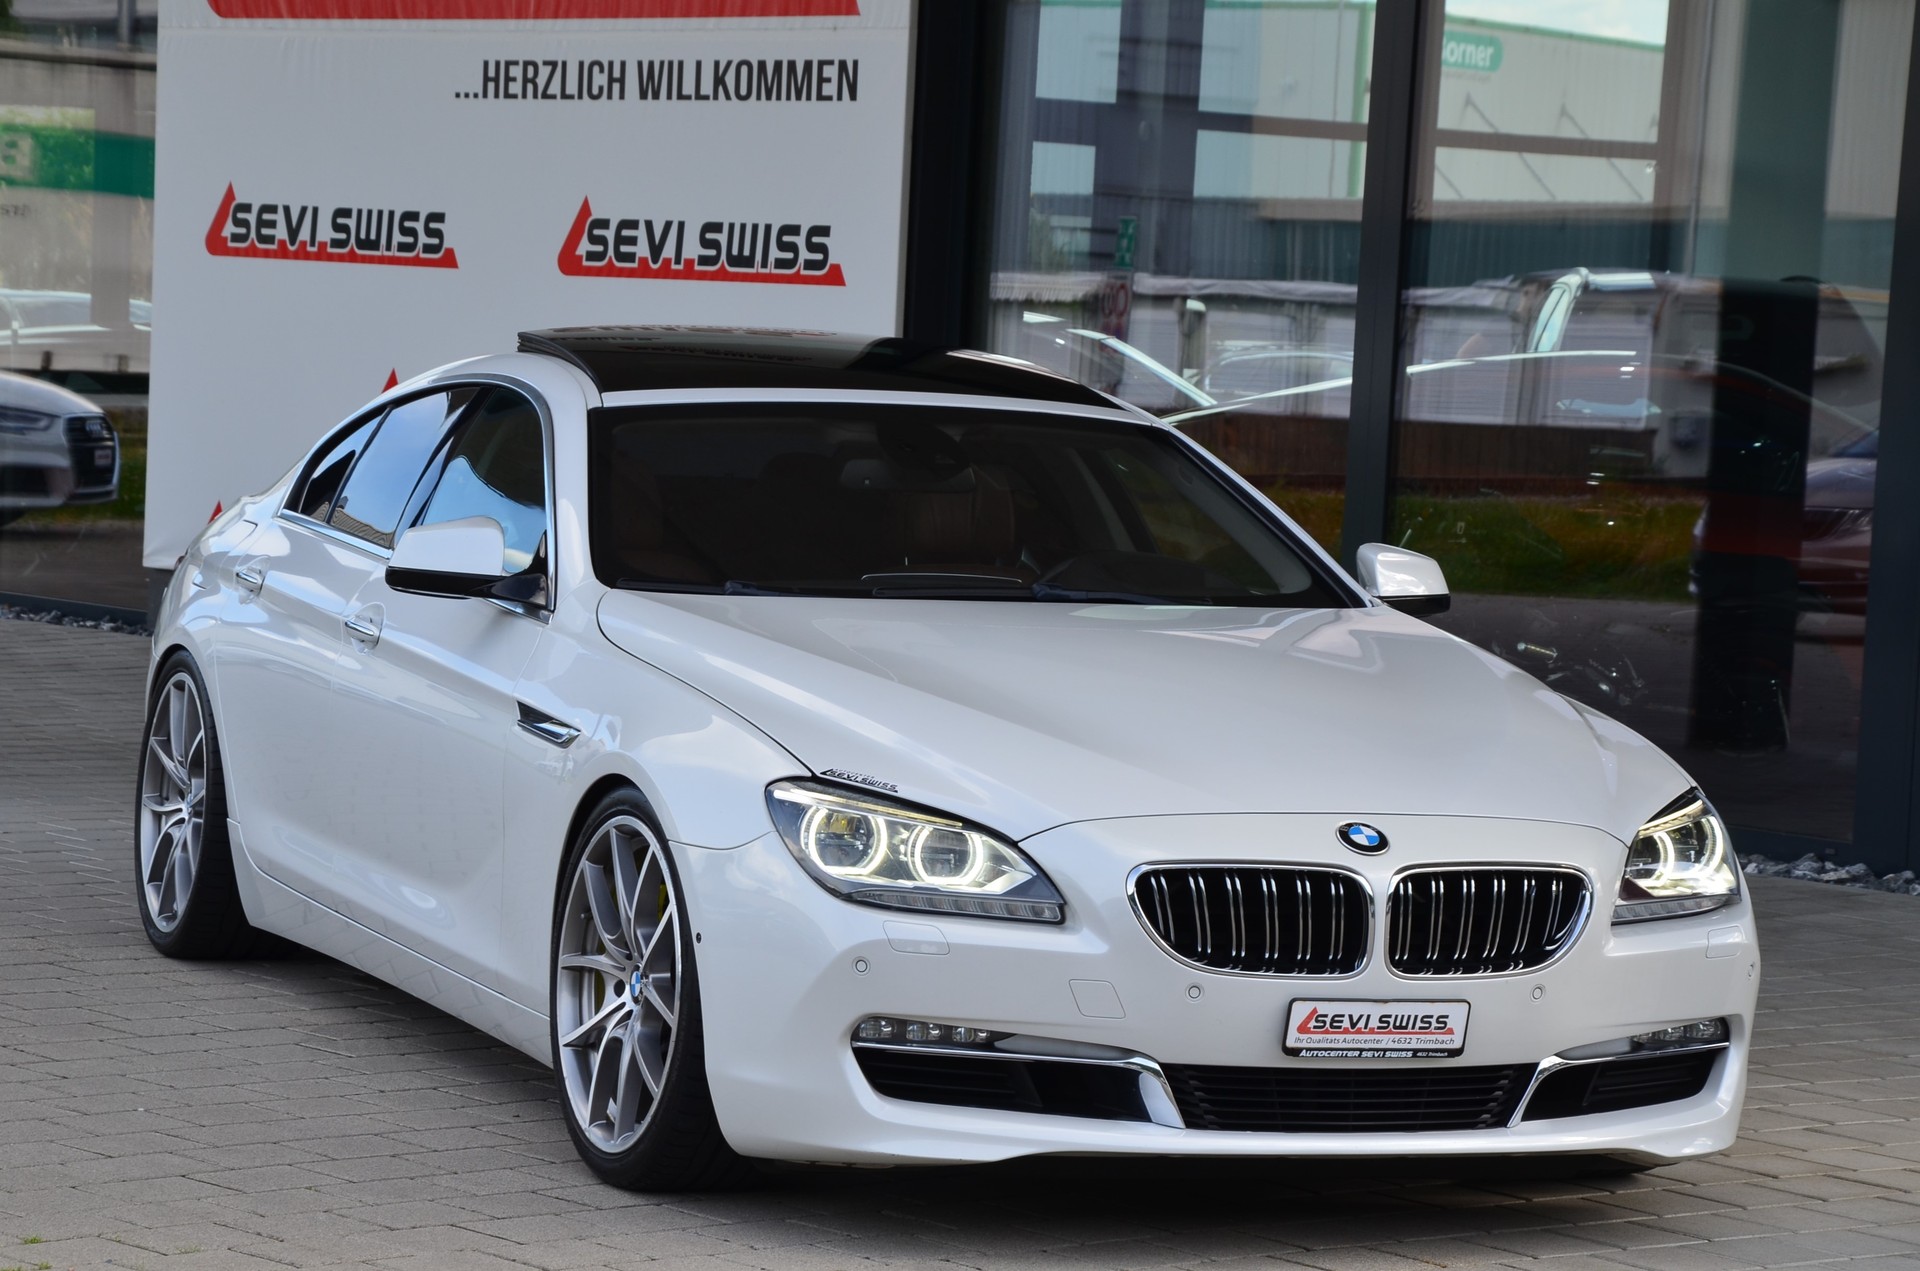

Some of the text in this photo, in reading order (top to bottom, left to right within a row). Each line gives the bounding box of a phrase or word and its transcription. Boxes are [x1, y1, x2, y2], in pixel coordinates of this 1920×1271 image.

[1442, 36, 1495, 68] orner
[454, 59, 859, 102] ...HERZLICH WILLKOMMEN
[229, 202, 447, 255] SEVI SWISS
[585, 218, 832, 271] SEVI SWISS
[828, 770, 859, 782] SEVI
[860, 777, 898, 791] SWISS
[1312, 1013, 1450, 1031] SEVI SWISS
[1341, 1037, 1384, 1045] Autocenter
[1415, 1037, 1455, 1045] Trimbach
